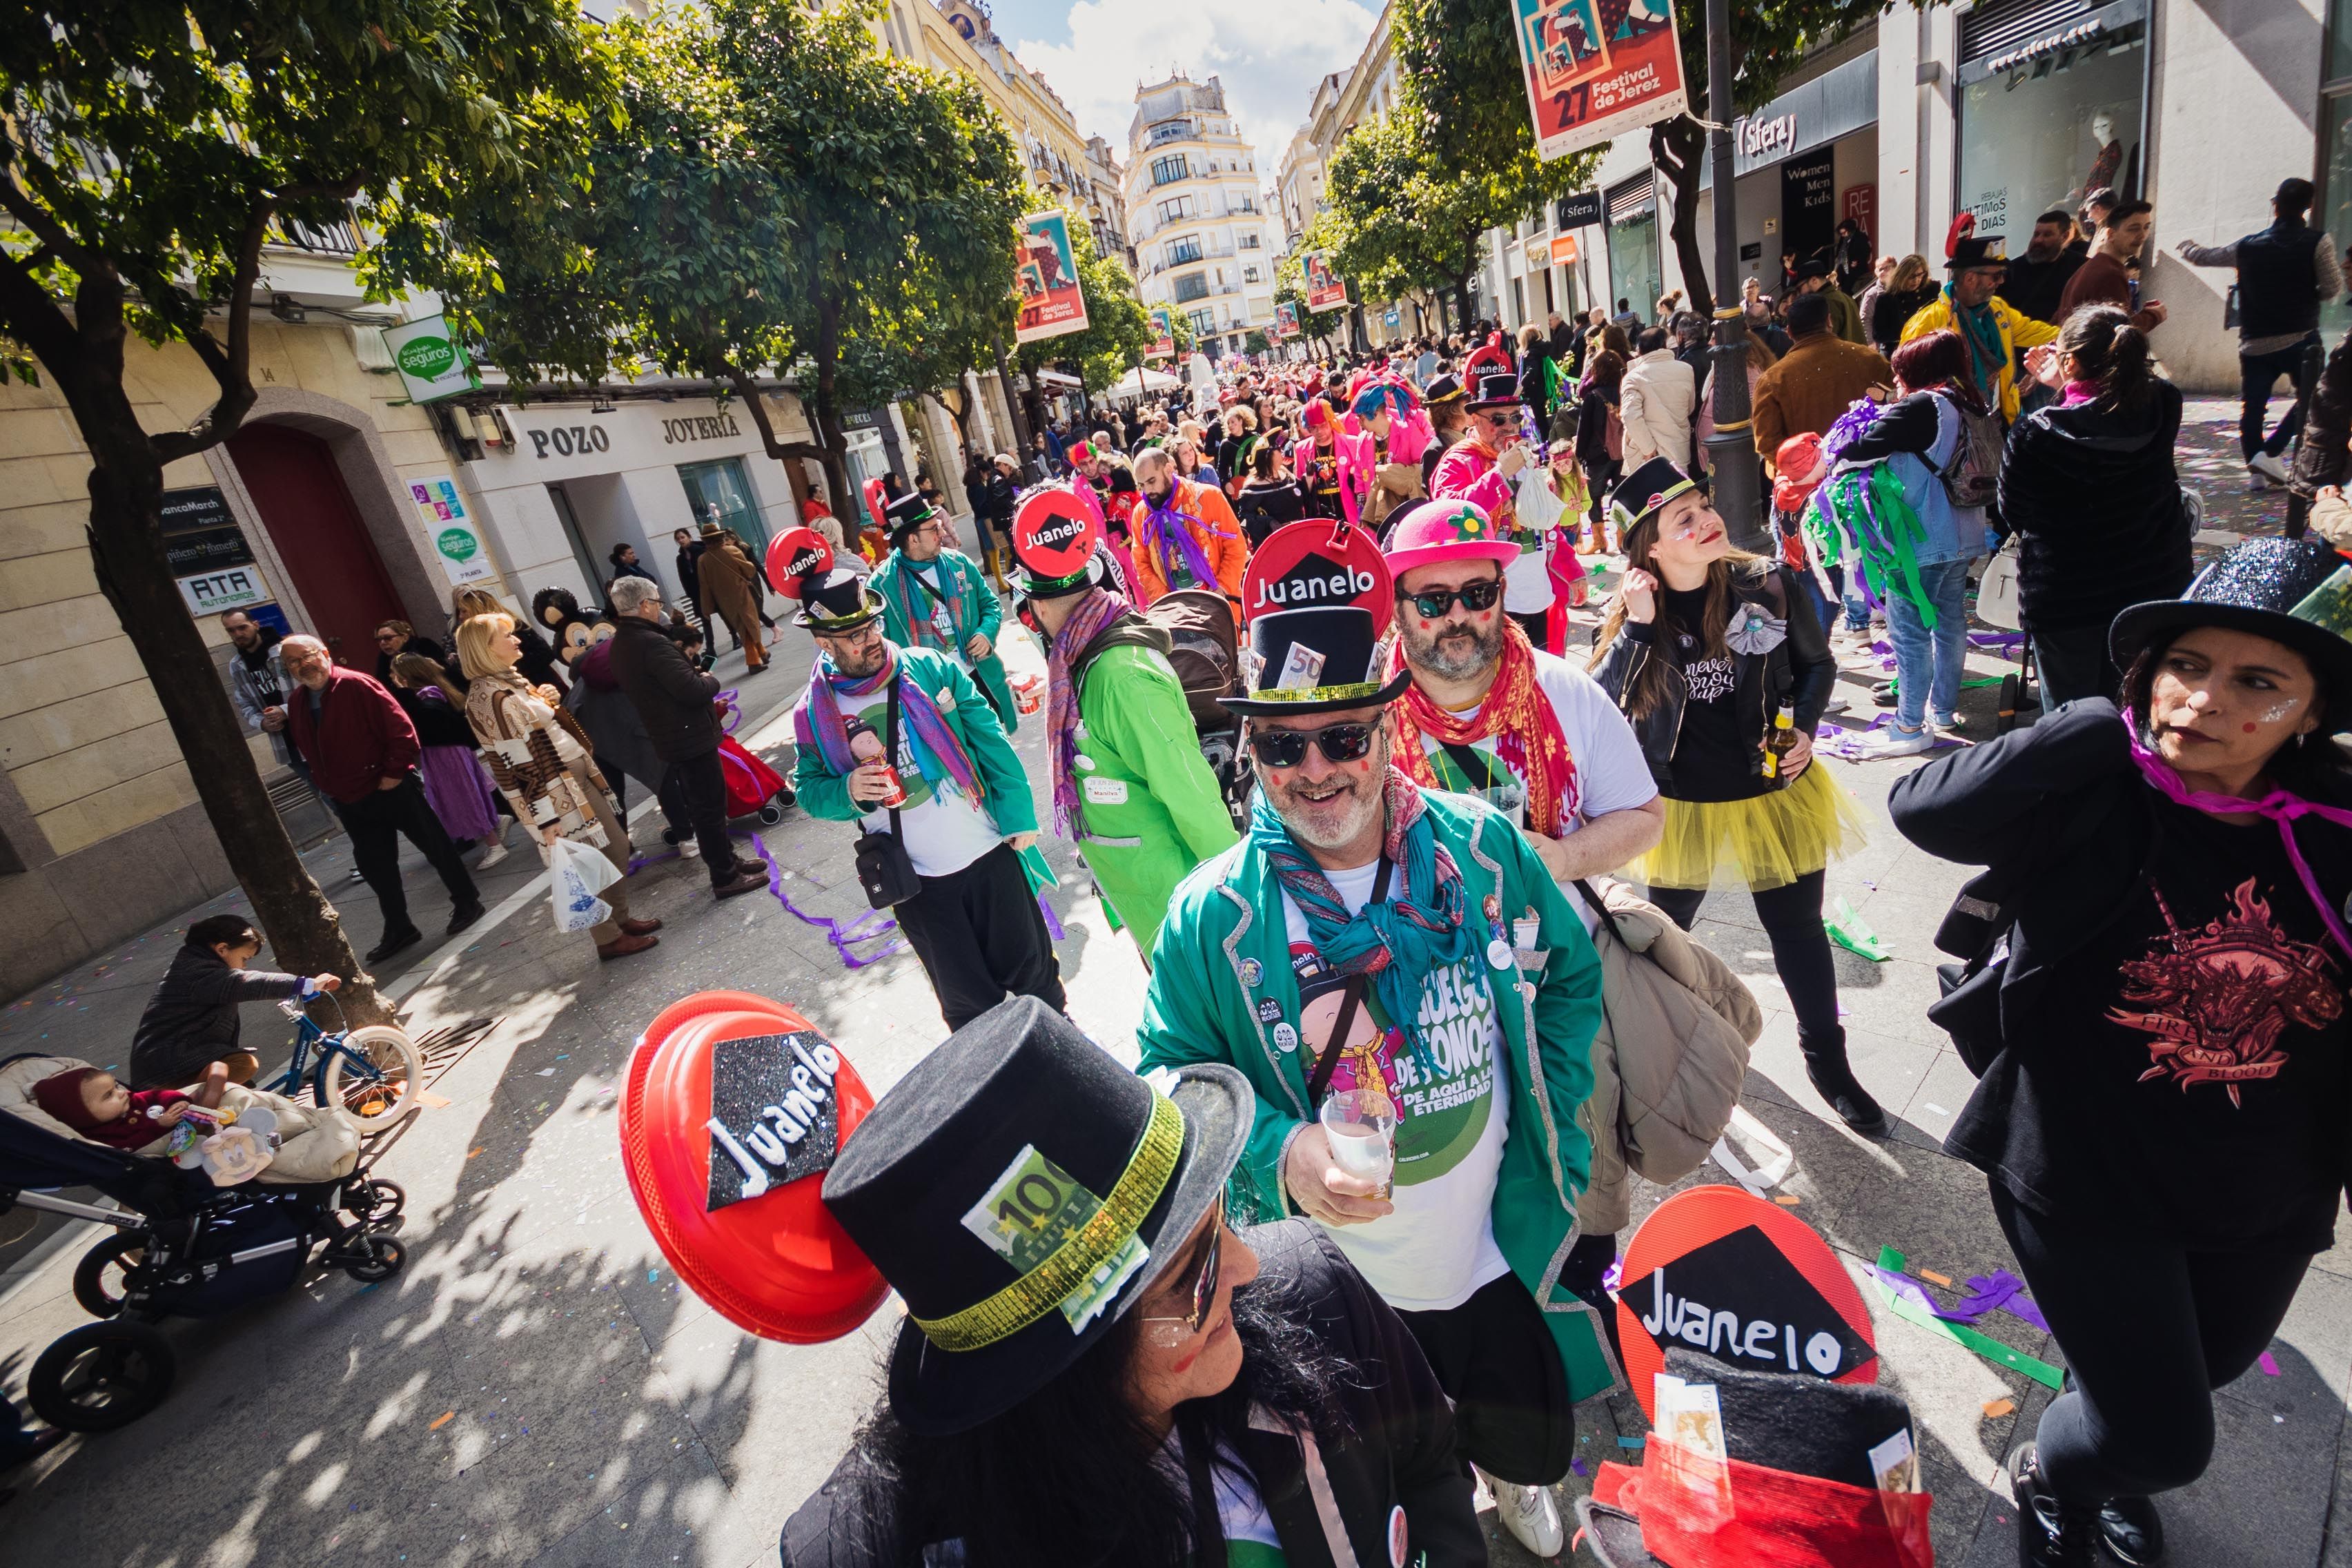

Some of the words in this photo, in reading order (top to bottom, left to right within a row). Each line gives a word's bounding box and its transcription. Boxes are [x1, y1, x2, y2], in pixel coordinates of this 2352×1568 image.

[1592, 62, 1654, 97] Festival
[1554, 80, 1590, 128] 27
[1594, 95, 1615, 110] de
[1618, 77, 1660, 101] Jerez
[1787, 164, 1830, 180] Women
[1807, 178, 1830, 191] Men
[1850, 190, 1870, 217] RE
[1981, 214, 2006, 231] DIAS
[1023, 306, 1039, 326] 27
[1041, 302, 1070, 314] Festival
[1055, 308, 1075, 317] Jerez
[403, 346, 451, 368] seguros
[1469, 363, 1507, 375] Juanelo
[260, 368, 275, 382] 14
[528, 424, 609, 458] POZO
[442, 538, 474, 552] seguros
[1026, 518, 1086, 550] Juanelo
[783, 548, 825, 581] Juanelo
[190, 571, 251, 606] ATA
[1253, 565, 1374, 608] Juanelo
[812, 602, 825, 616] 50
[1290, 647, 1322, 680] 50
[1685, 656, 1734, 676] never
[1694, 686, 1734, 704] up
[2142, 1016, 2197, 1040] FIRE
[2183, 1049, 2233, 1066] AND
[1394, 1055, 1420, 1090] DE
[2208, 1066, 2272, 1079] BLOOD
[1403, 1090, 1425, 1107] DE
[1429, 1073, 1467, 1101] AQUÍ
[1470, 1074, 1480, 1088] A
[1480, 1065, 1493, 1081] LA
[1413, 1080, 1491, 1117] ETERNIDAD
[706, 1035, 840, 1199] Juanelo
[1643, 1267, 1842, 1375] Juanelo
